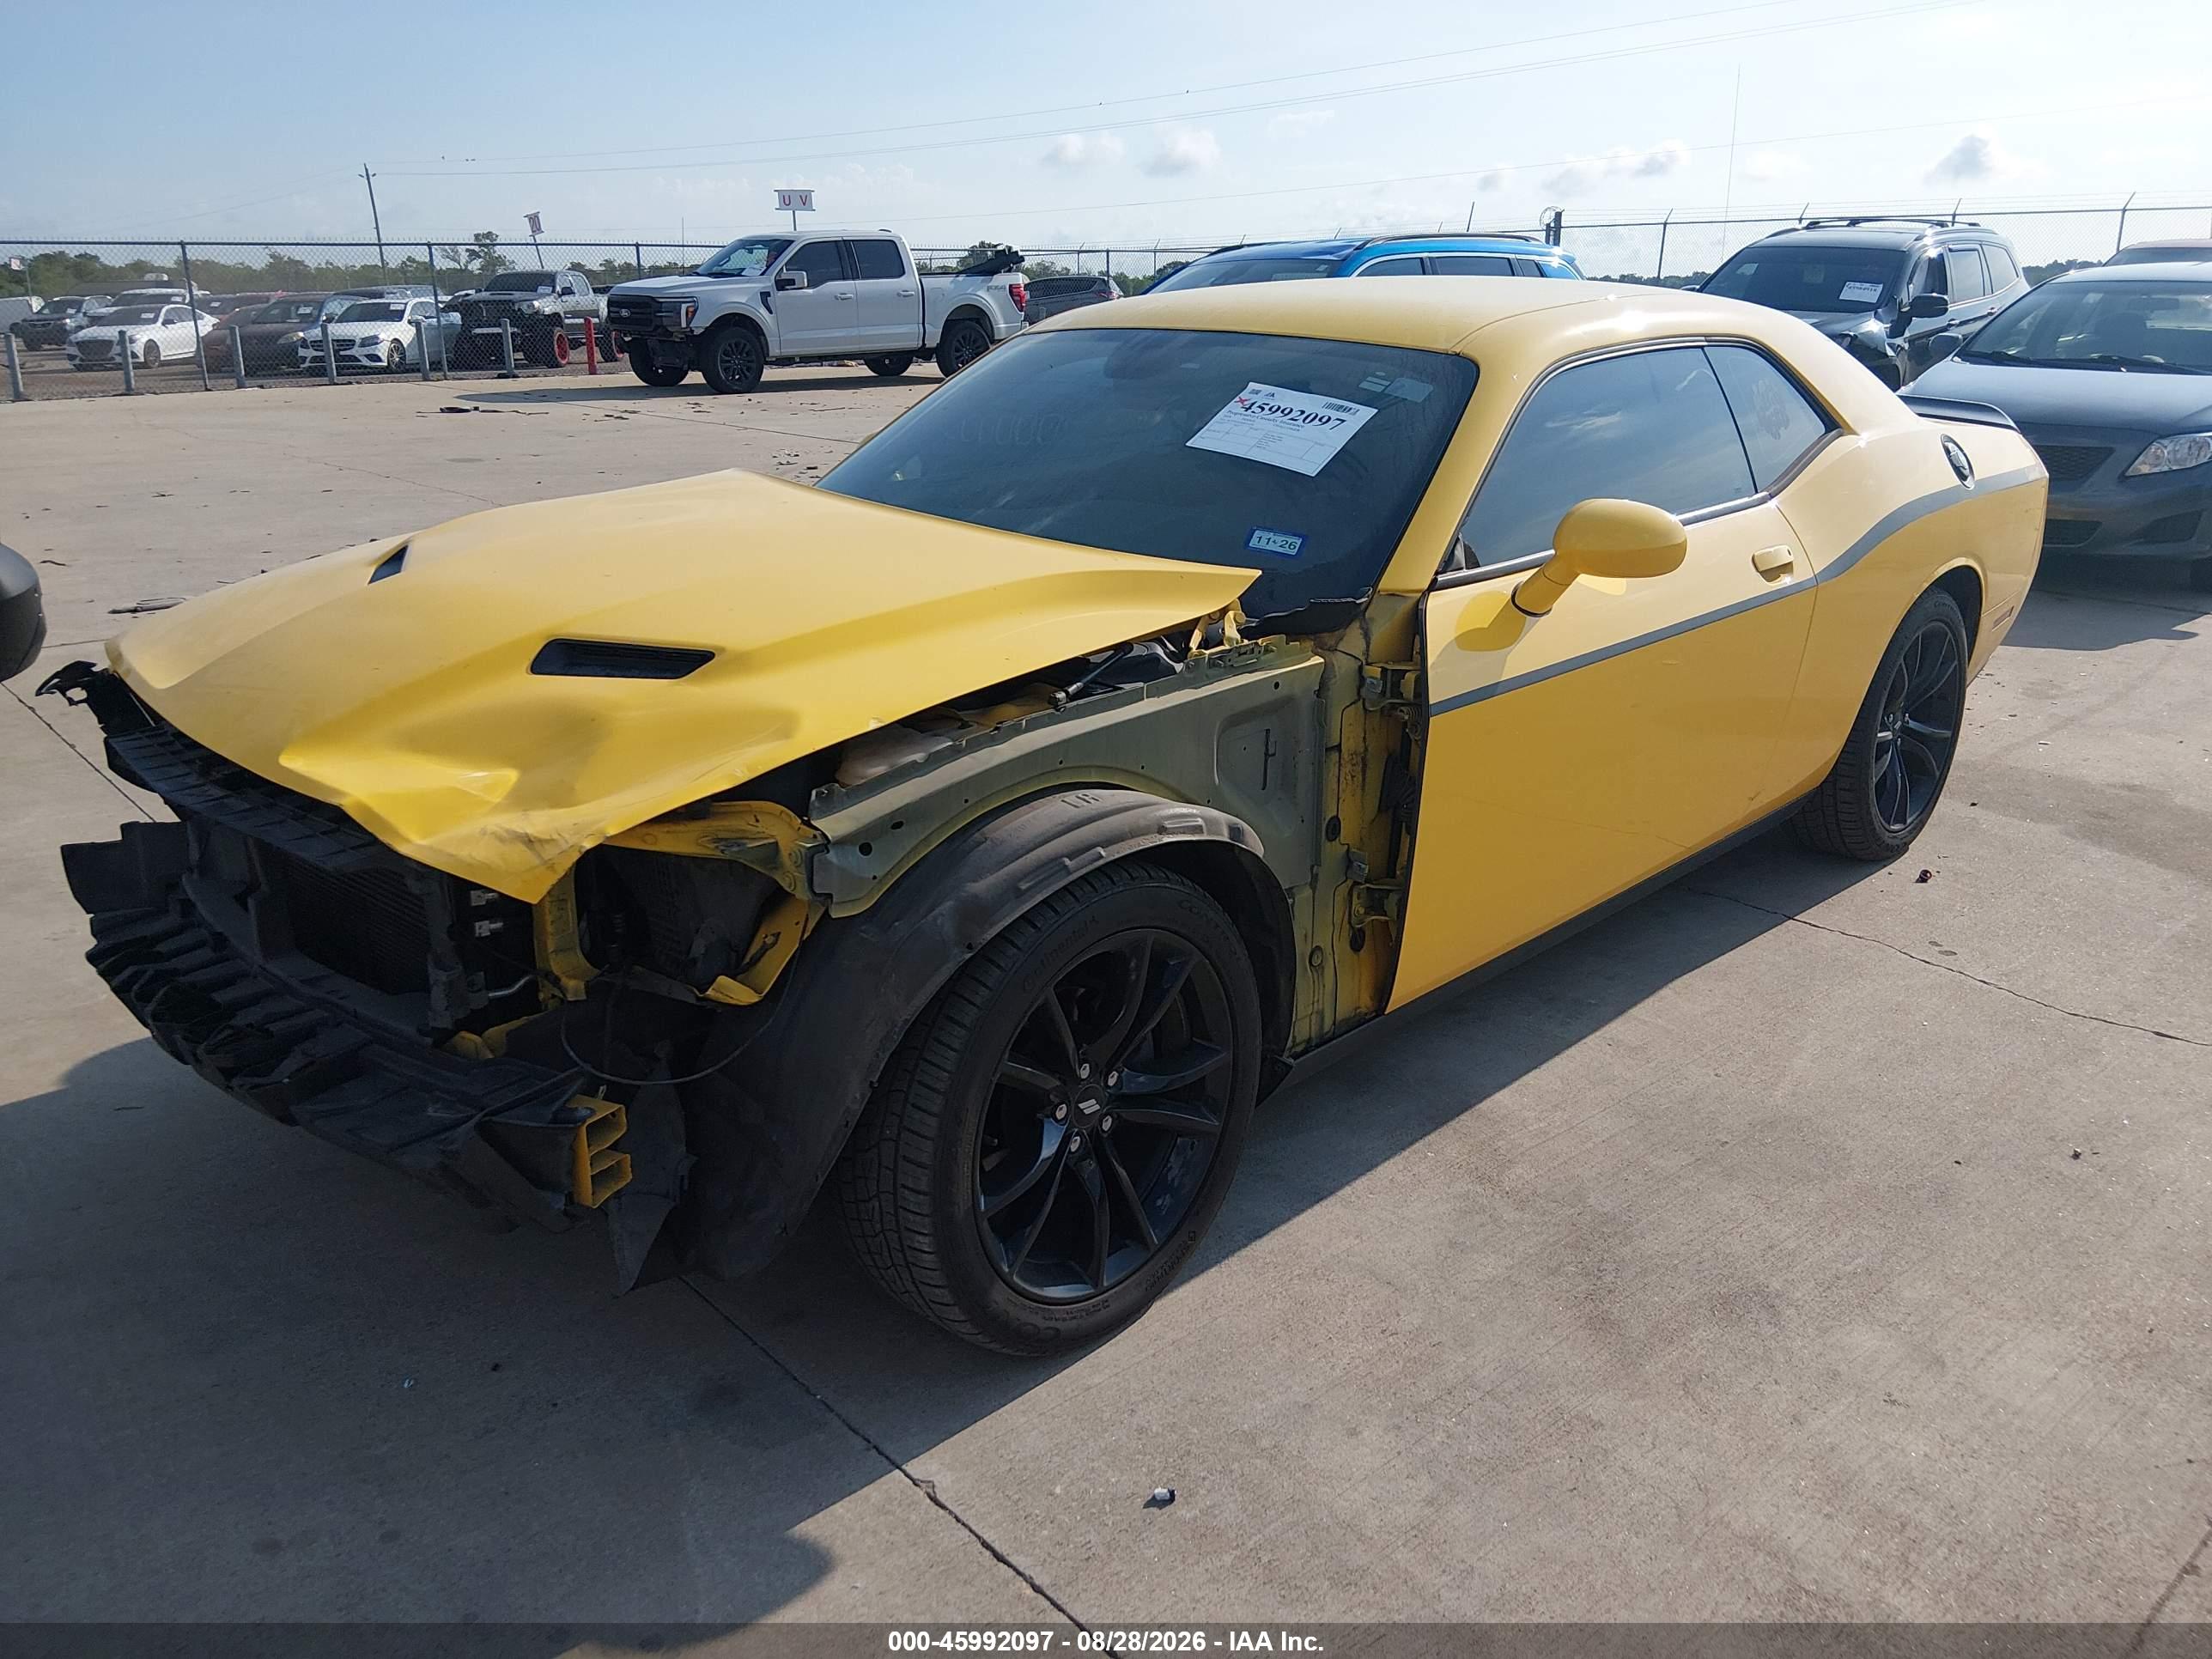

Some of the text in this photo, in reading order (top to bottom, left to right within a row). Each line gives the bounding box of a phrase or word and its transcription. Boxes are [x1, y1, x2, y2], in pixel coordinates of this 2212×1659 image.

[782, 194, 808, 206] U V
[528, 215, 542, 233] 20
[1241, 400, 1346, 430] 45992097
[1279, 539, 1297, 550] 26
